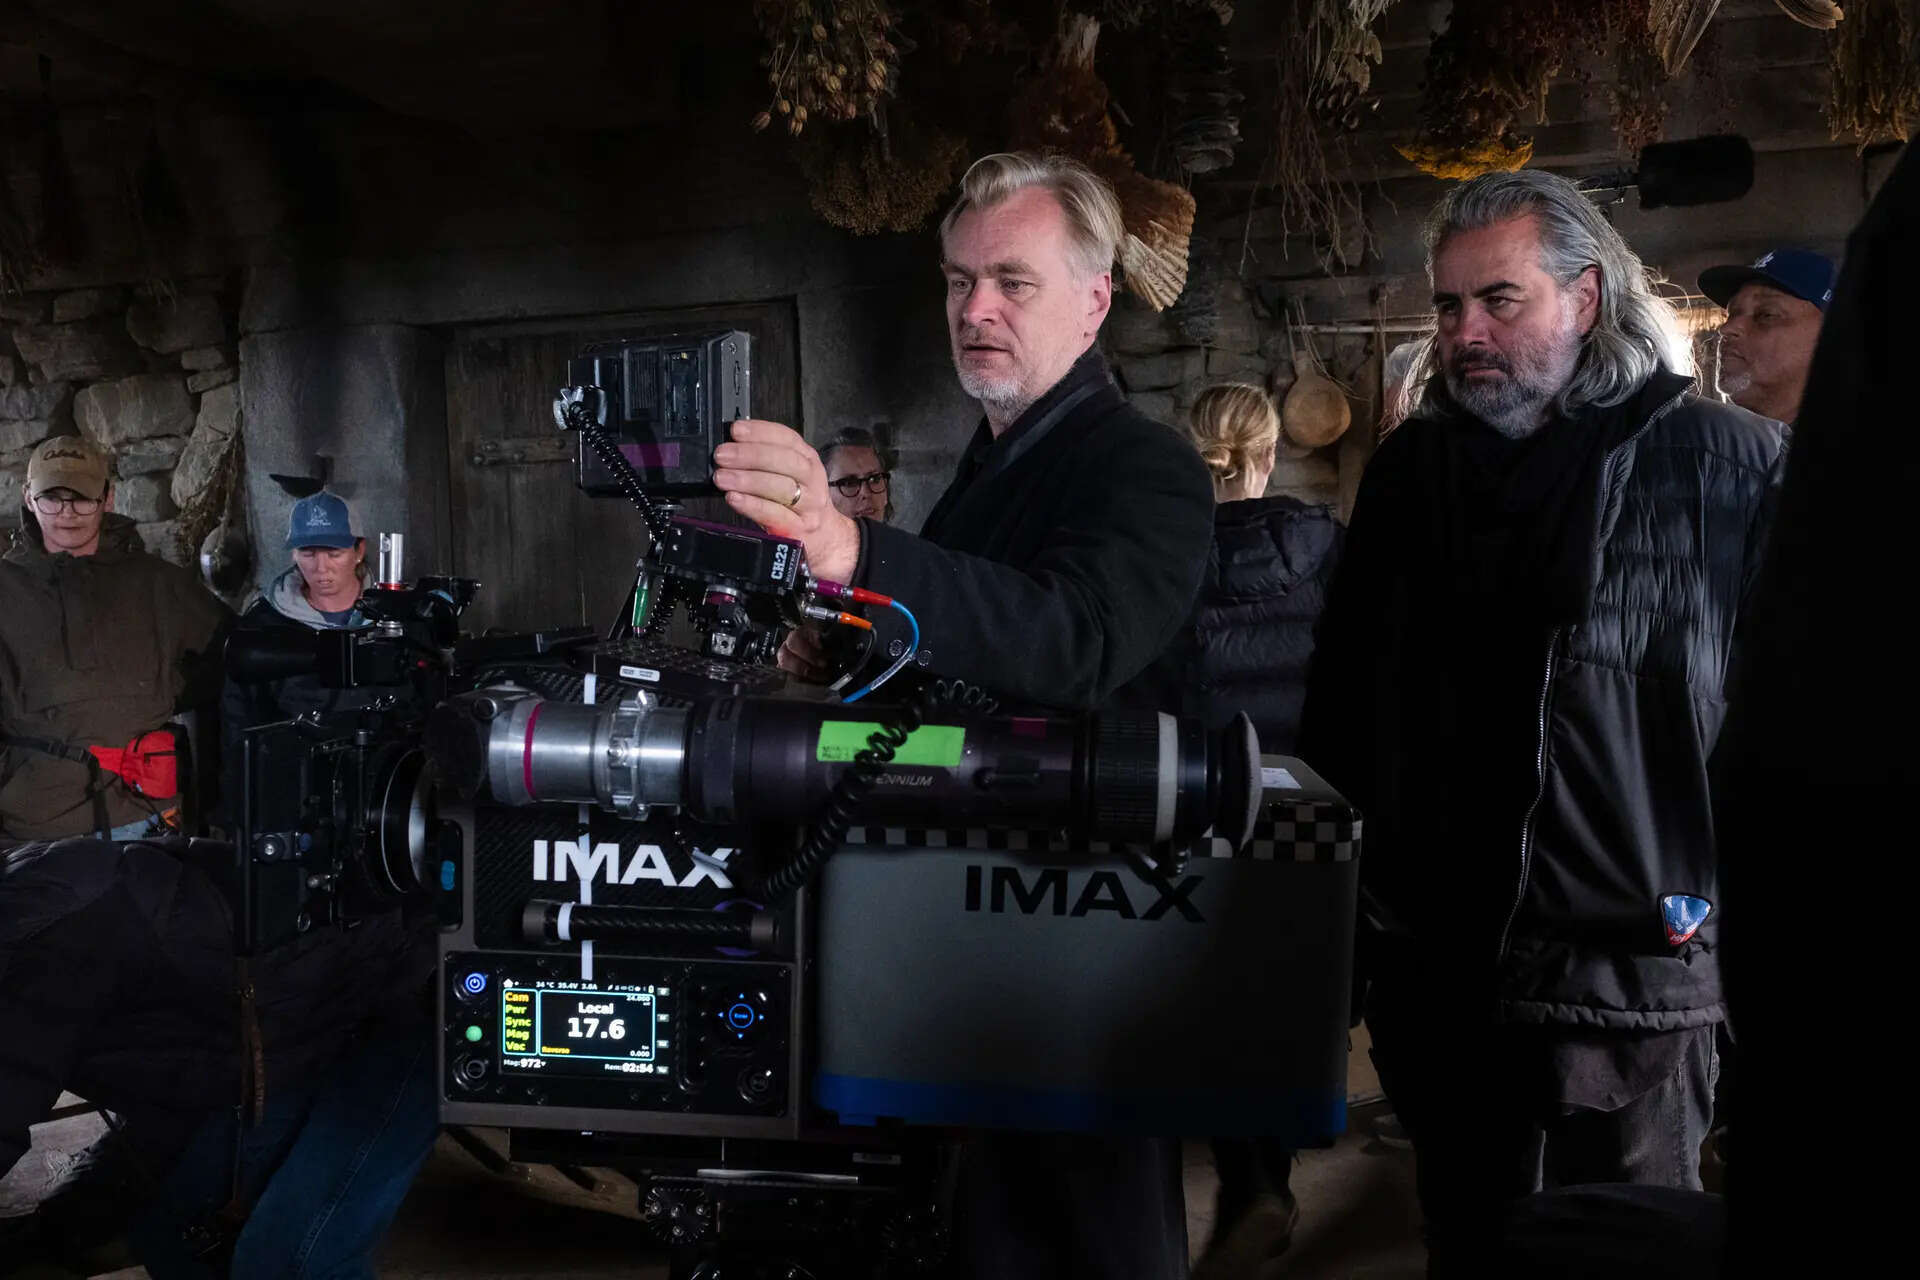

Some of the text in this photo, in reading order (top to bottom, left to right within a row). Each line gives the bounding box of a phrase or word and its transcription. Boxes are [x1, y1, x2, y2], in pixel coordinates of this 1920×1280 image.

[533, 839, 735, 889] IMAX
[965, 865, 1207, 922] IMAX
[504, 992, 530, 1002] Cam
[505, 1004, 527, 1014] Pwr
[578, 1002, 614, 1015] Local
[505, 1016, 532, 1028] Sync
[567, 1017, 626, 1039] 17.6
[506, 1029, 530, 1040] Mag
[506, 1041, 526, 1051] Vac
